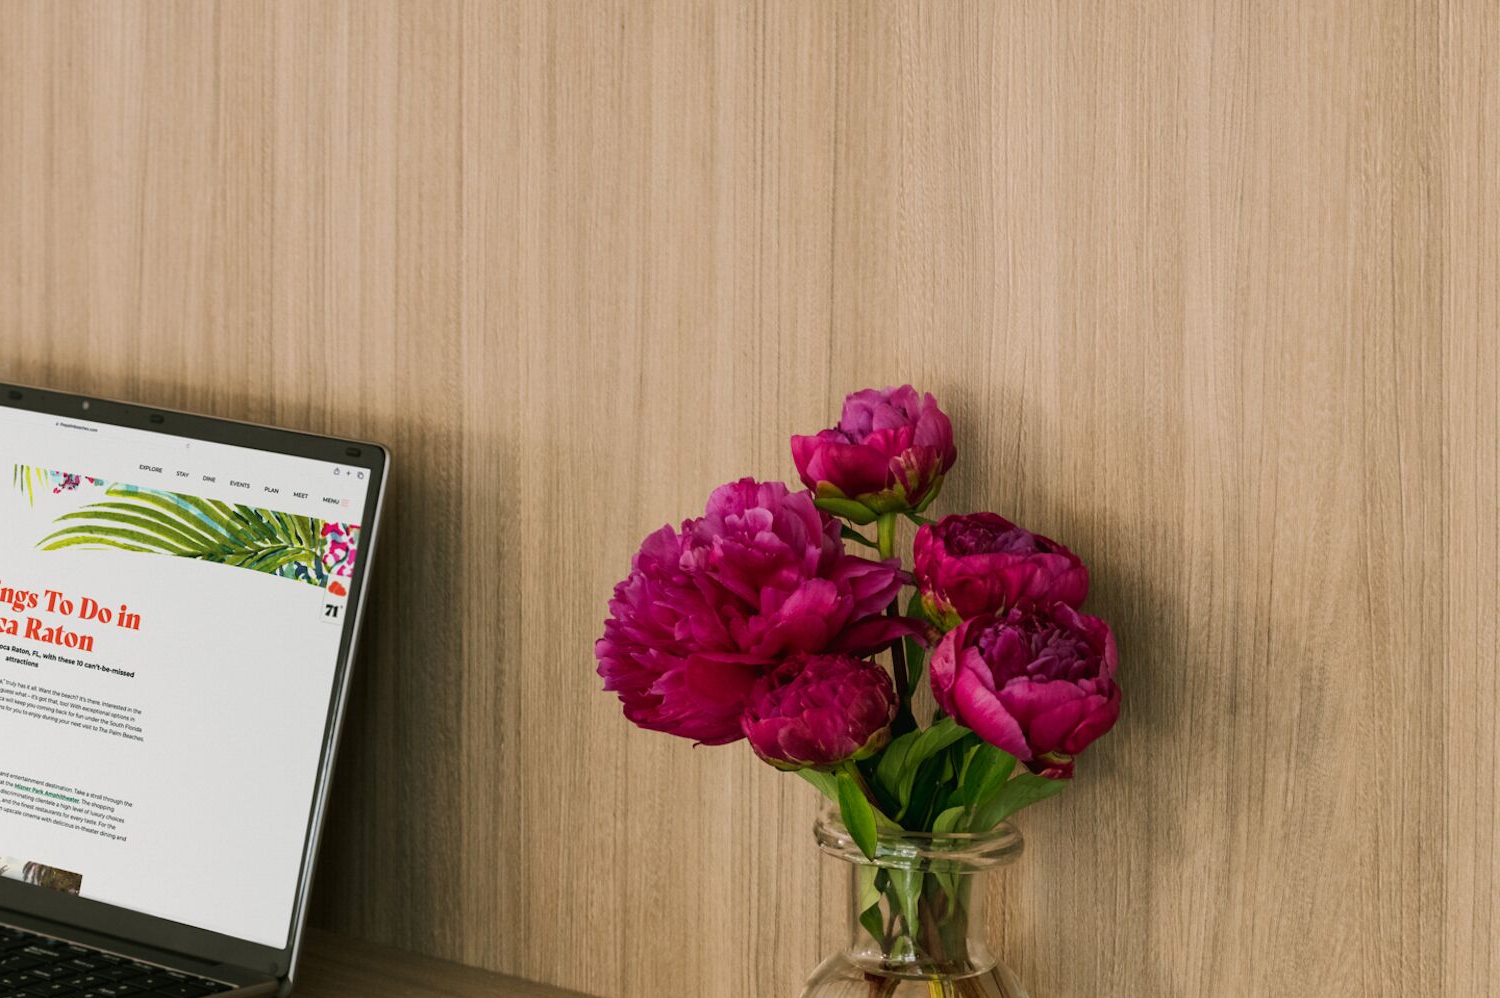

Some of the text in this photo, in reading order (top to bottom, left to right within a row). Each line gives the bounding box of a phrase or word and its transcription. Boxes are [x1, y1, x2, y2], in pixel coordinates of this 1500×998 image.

[139, 464, 163, 474] EXPLORE
[176, 470, 190, 478] STAY
[202, 475, 216, 483] DINE
[229, 480, 251, 489] EVENTS
[264, 486, 280, 494] PLAN
[322, 497, 340, 505] MENU
[44, 589, 74, 616] To
[78, 597, 112, 624] Do
[117, 604, 141, 631] in
[24, 617, 94, 652] Raton
[5, 656, 39, 668] attractions
[11, 645, 31, 656] Raton,
[32, 650, 42, 659] FL,
[42, 653, 57, 661] with
[57, 656, 76, 665] these
[76, 659, 84, 667] 10
[84, 662, 135, 678] can't-be-missed
